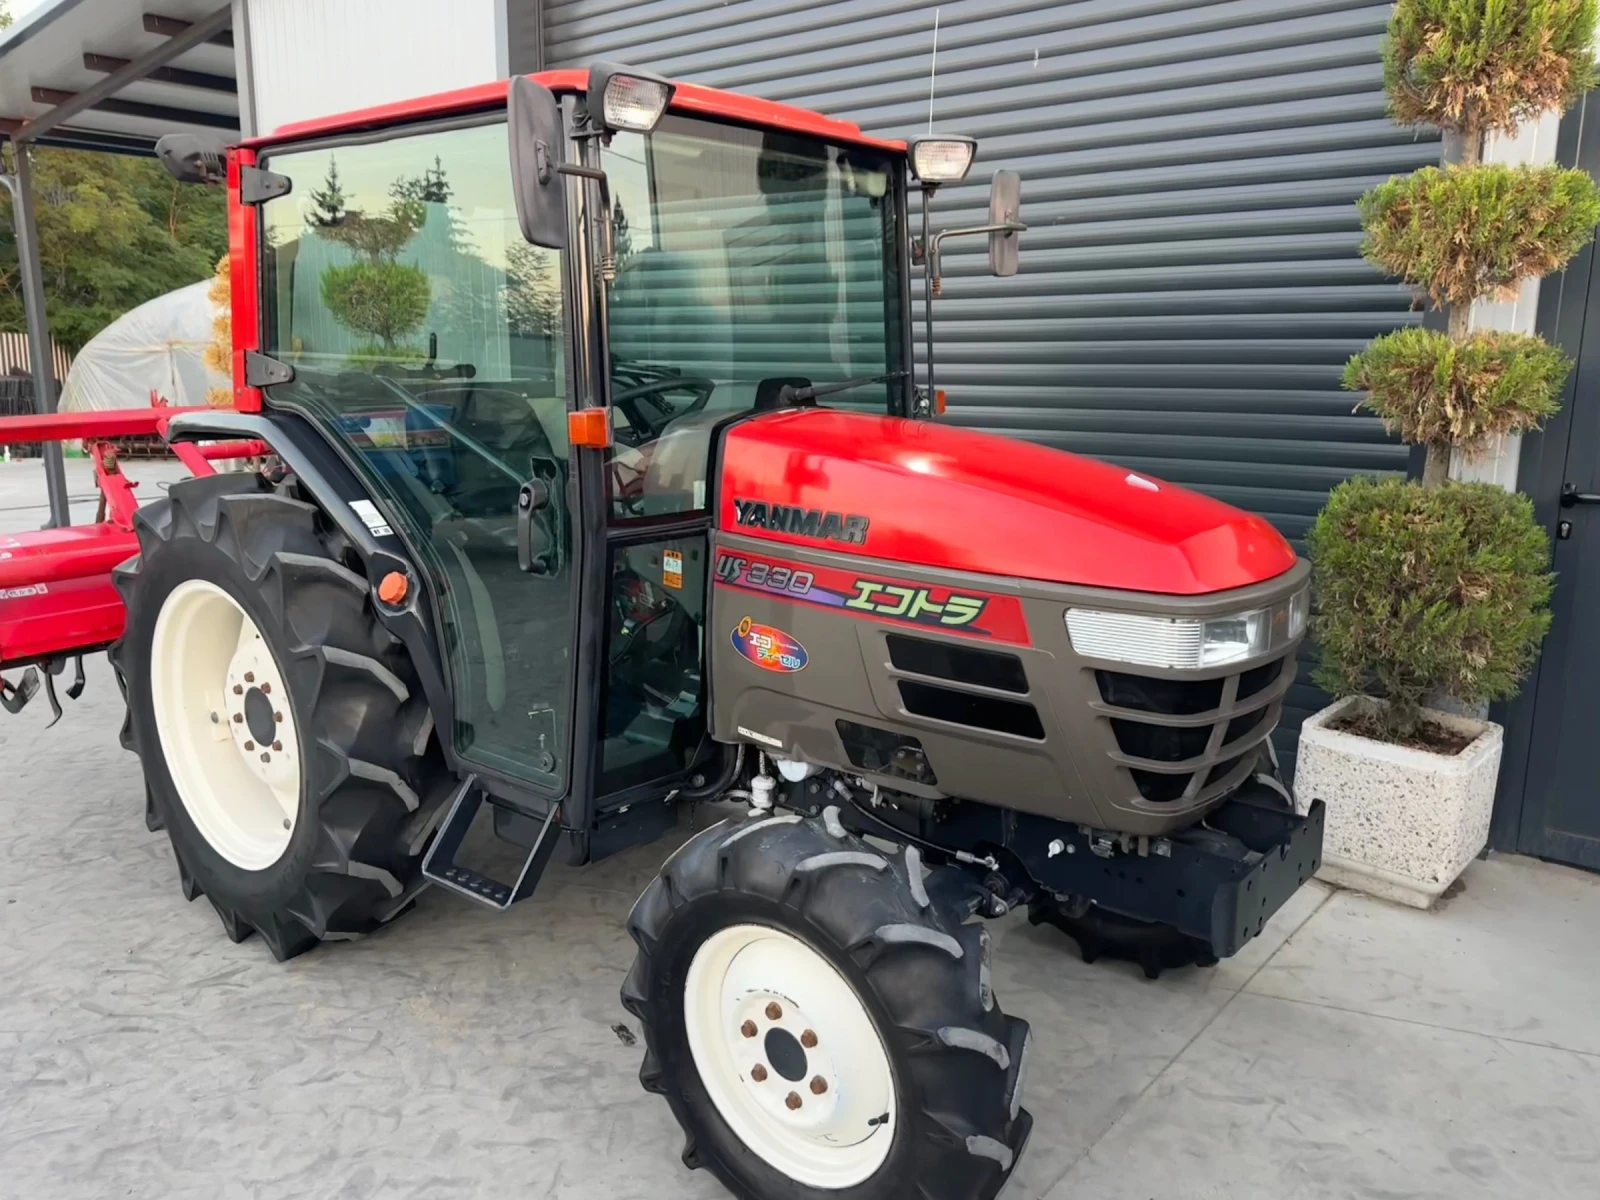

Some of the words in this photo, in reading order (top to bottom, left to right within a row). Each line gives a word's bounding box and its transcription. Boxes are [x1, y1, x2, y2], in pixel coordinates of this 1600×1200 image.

[734, 499, 869, 545] YANMAR
[845, 580, 985, 626] エコトラ
[749, 632, 772, 649] エコ
